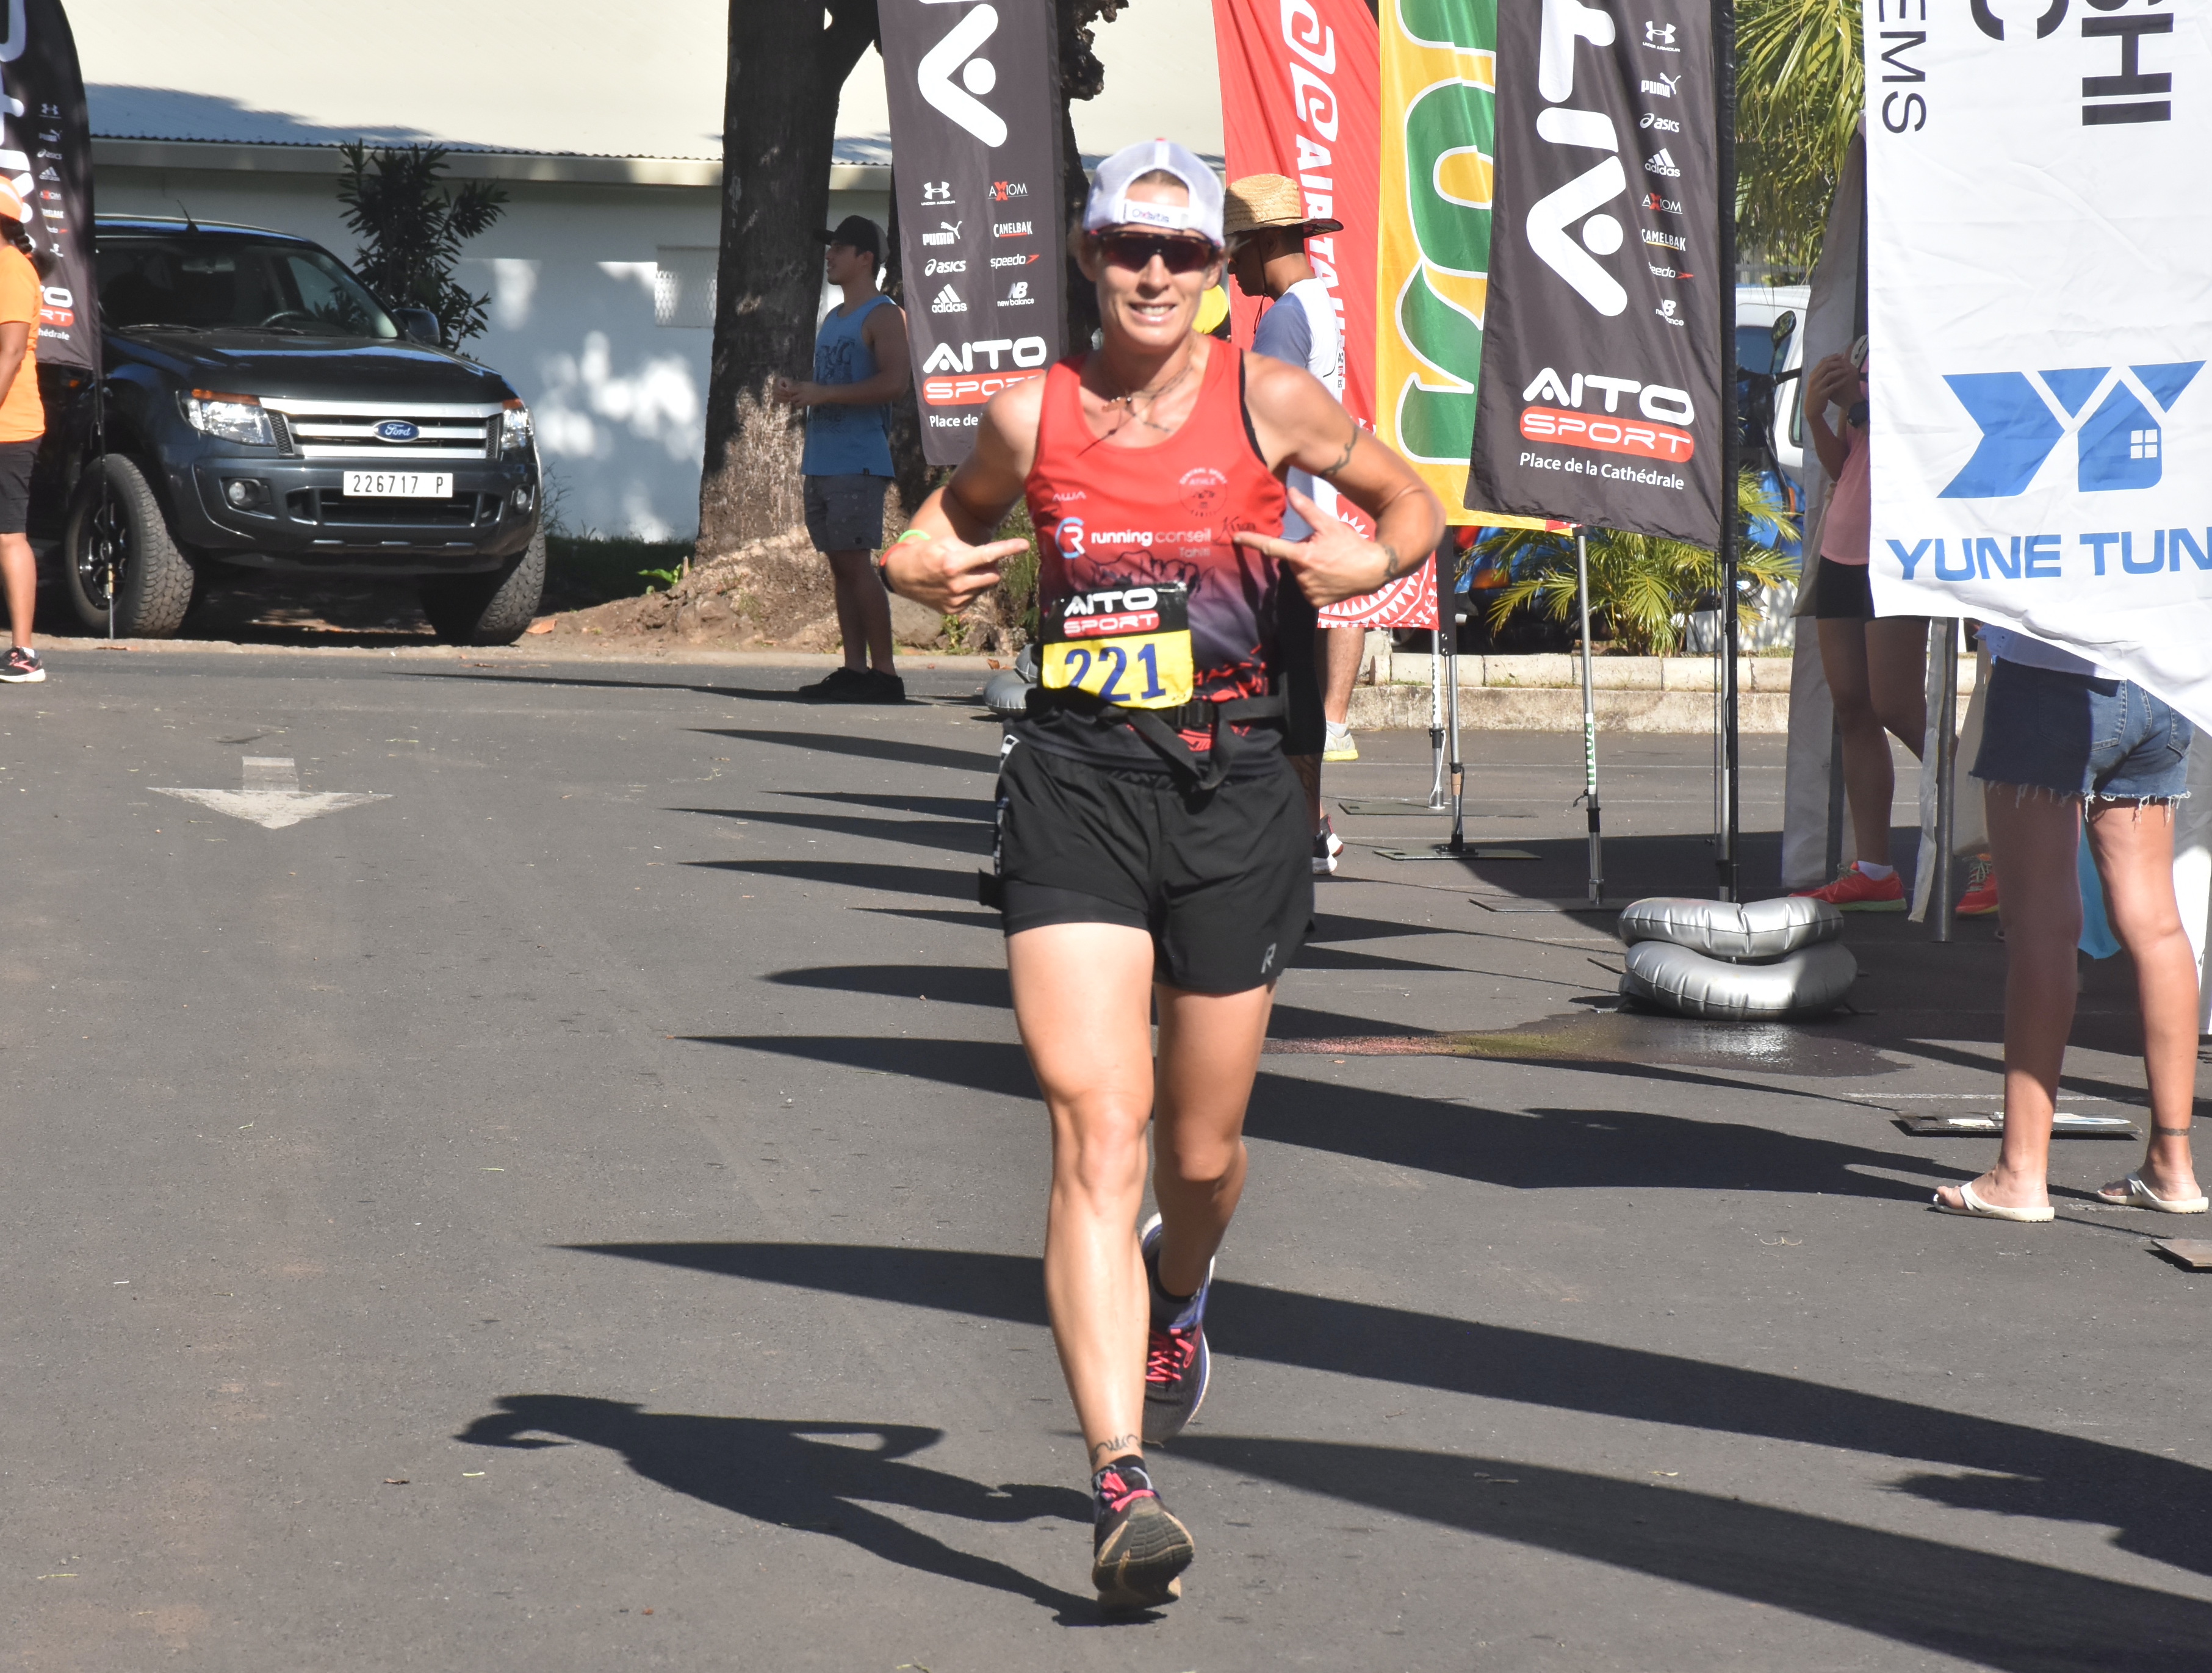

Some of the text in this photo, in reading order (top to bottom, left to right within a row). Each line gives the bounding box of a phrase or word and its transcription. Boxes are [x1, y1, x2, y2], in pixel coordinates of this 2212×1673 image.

[1641, 80, 1670, 98] PUMA
[1654, 117, 1679, 133] asics
[1645, 162, 1681, 178] adidas
[989, 181, 1028, 201] AXIOM
[1643, 192, 1682, 212] AXIOM
[922, 232, 954, 245] PUMA
[993, 221, 1032, 237] CAMELBAK
[1641, 228, 1686, 251] CAMELBAK
[936, 260, 966, 273] asics
[990, 253, 1026, 269] speedo
[931, 301, 968, 313] adidas
[38, 328, 70, 340] hédrale
[923, 336, 1047, 373] AITO
[926, 375, 1039, 399] SPO
[1522, 367, 1695, 426] AITO
[384, 423, 411, 436] Ford
[929, 413, 979, 428] Place de
[1523, 413, 1691, 454] SPORT
[1519, 452, 1685, 490] Place de la Cathédrale
[353, 474, 444, 494] 226717 P
[1091, 528, 1153, 547] running
[1885, 534, 2062, 581] YUNE
[1064, 587, 1158, 617] AITO
[1064, 612, 1159, 635] SPORT
[1064, 642, 1166, 702] 221
